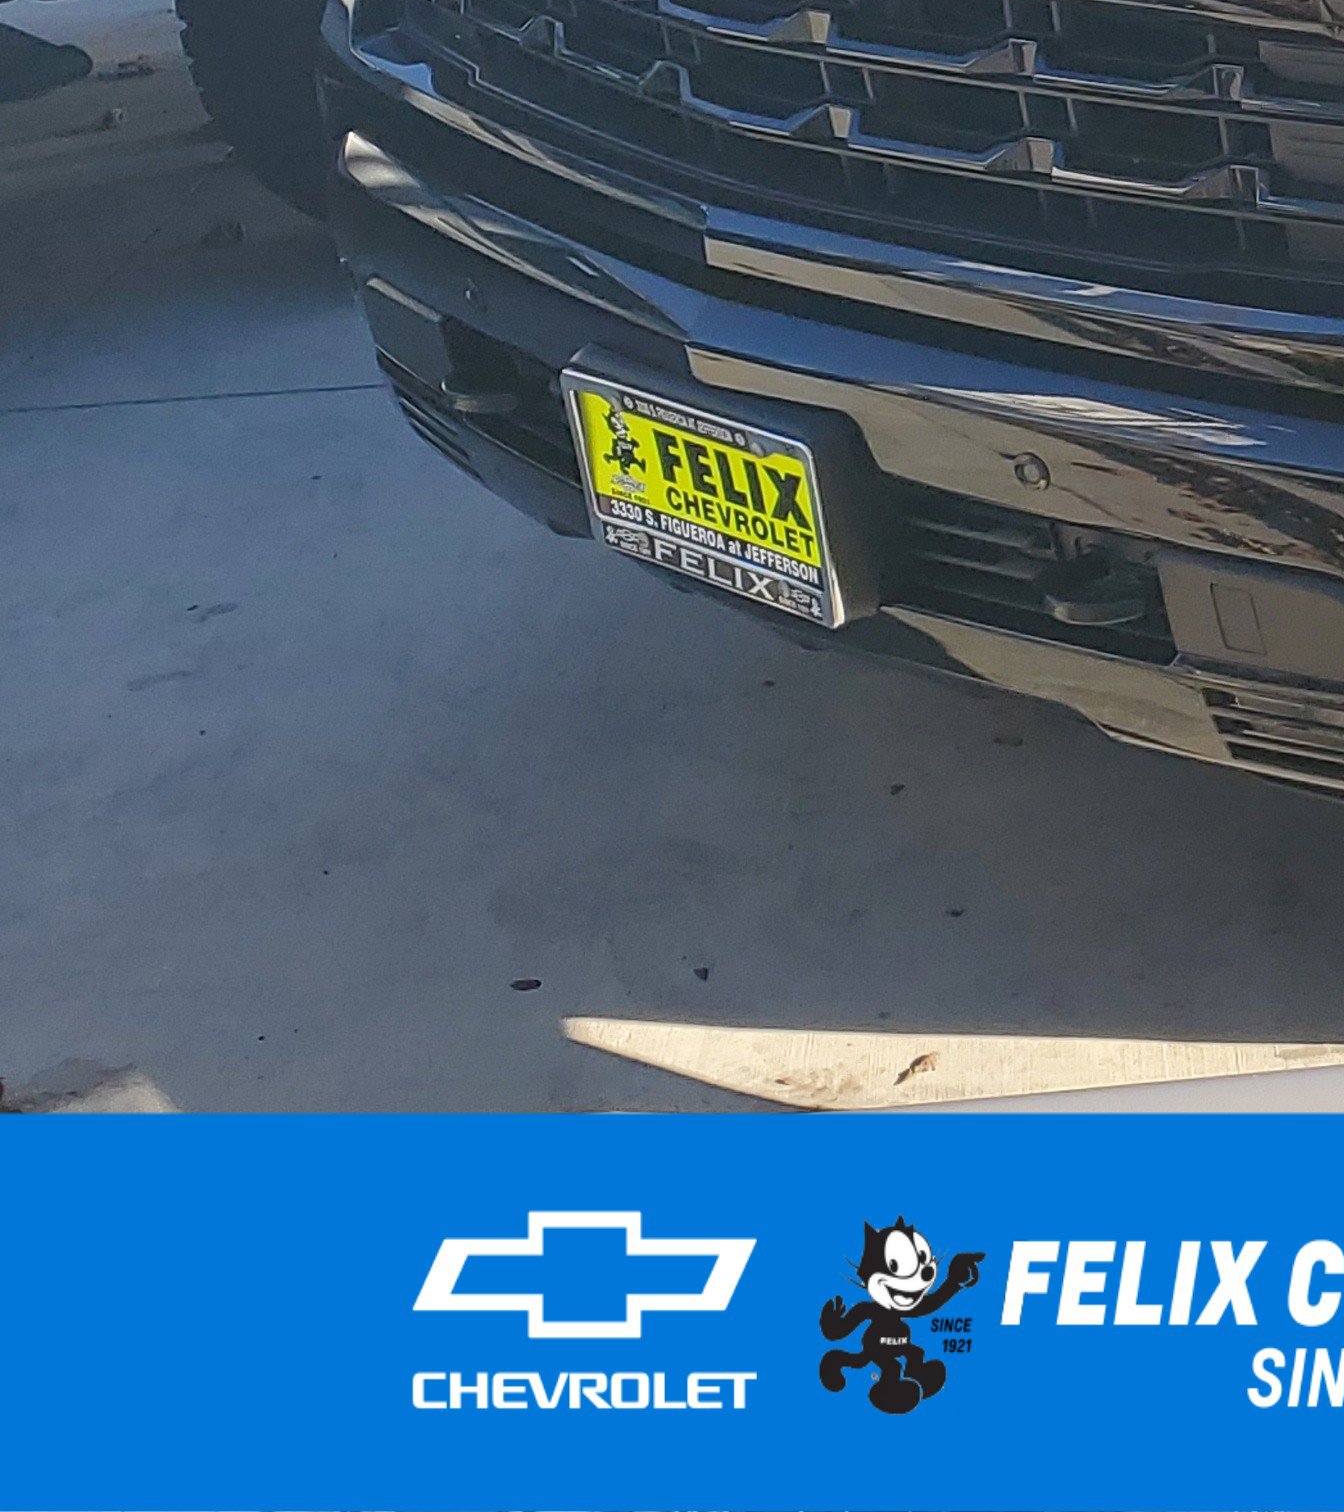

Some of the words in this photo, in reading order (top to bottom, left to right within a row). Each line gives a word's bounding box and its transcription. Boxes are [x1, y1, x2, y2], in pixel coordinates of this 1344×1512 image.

[652, 428, 813, 531] FELIX
[611, 498, 643, 522] 3330
[660, 513, 726, 552] FIGUEROA
[728, 539, 742, 555] at
[744, 543, 819, 584] JEFFERSON
[665, 486, 814, 558] CHEVROLET
[653, 538, 775, 601] FELIX
